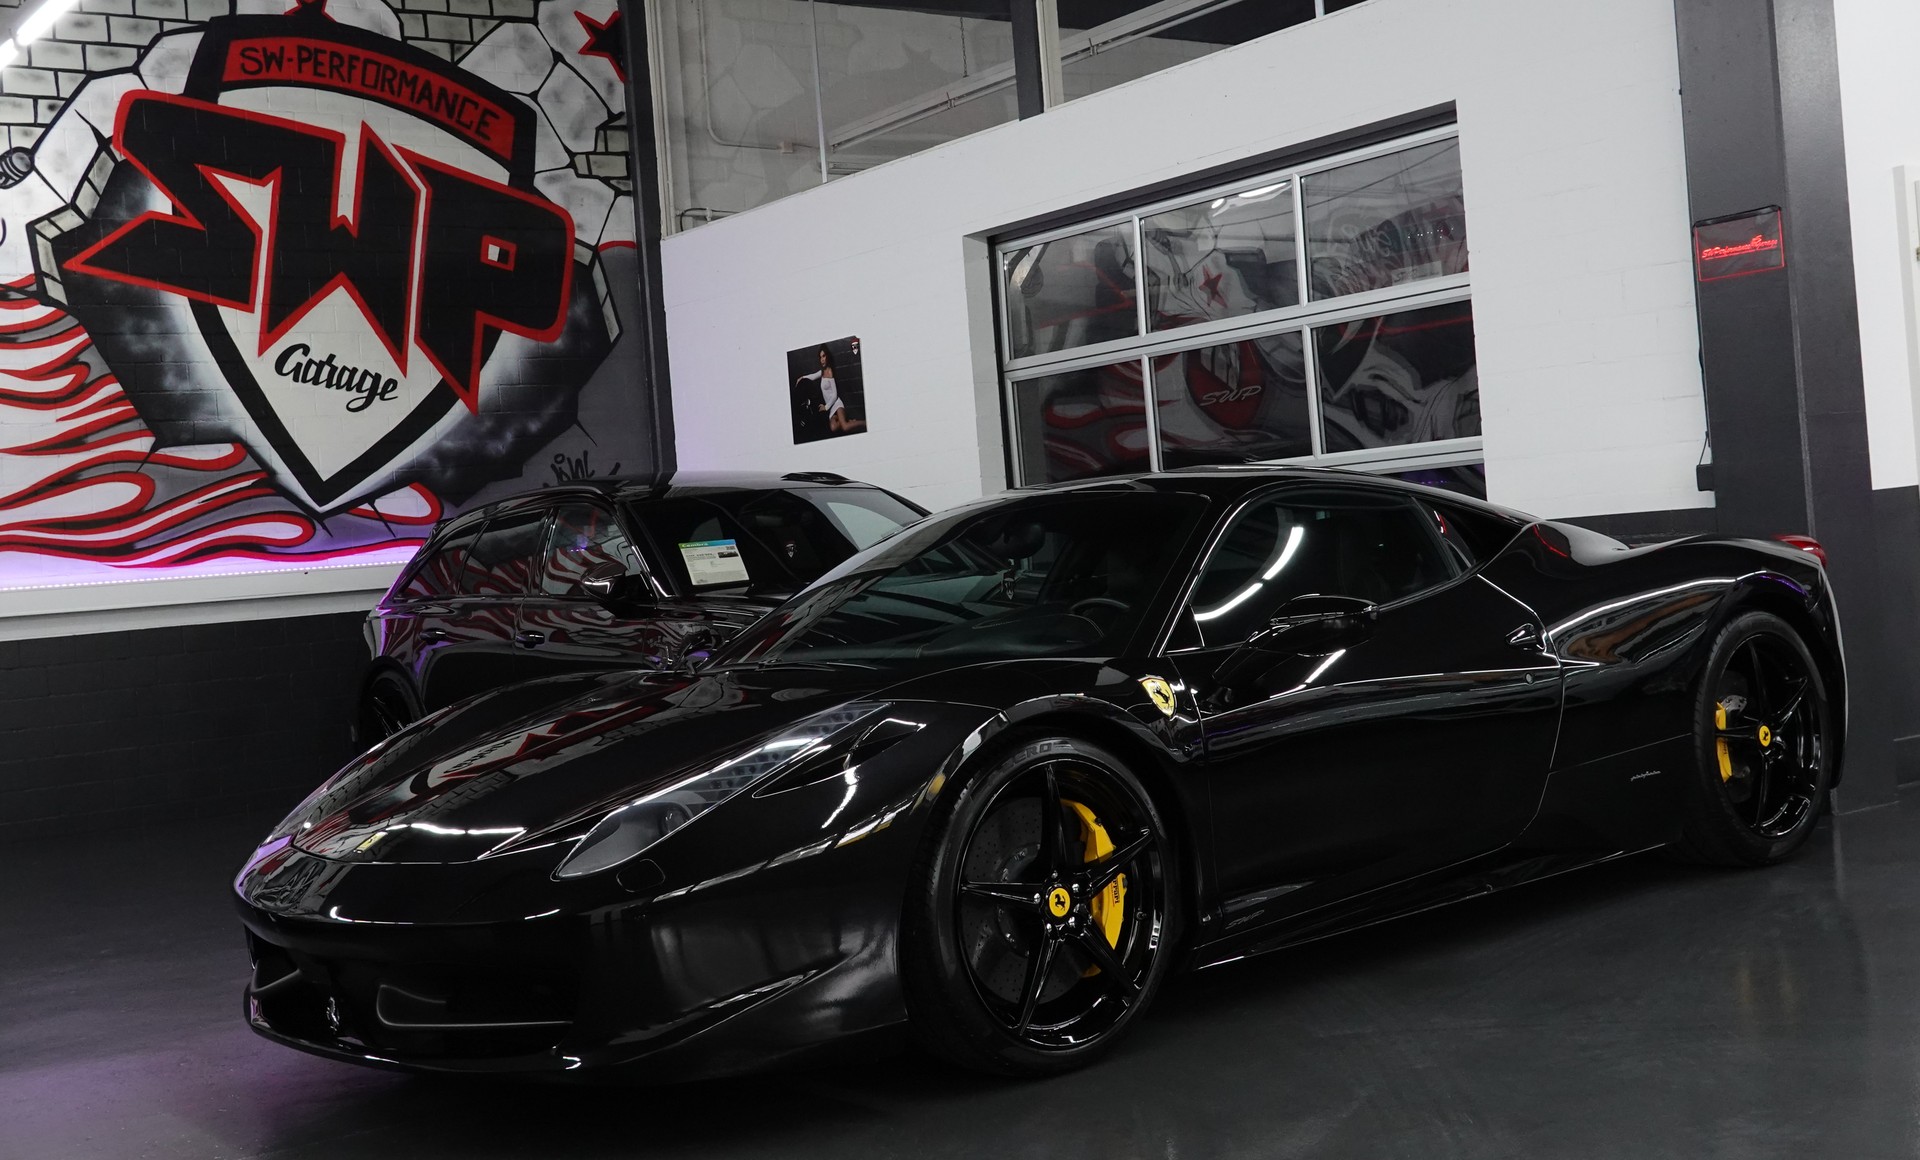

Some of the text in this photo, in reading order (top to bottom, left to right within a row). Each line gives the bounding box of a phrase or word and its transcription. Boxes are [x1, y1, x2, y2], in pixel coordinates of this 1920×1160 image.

[240, 45, 500, 141] SW-PERFORMANCE
[63, 89, 576, 417] SWP
[275, 343, 398, 412] Garage
